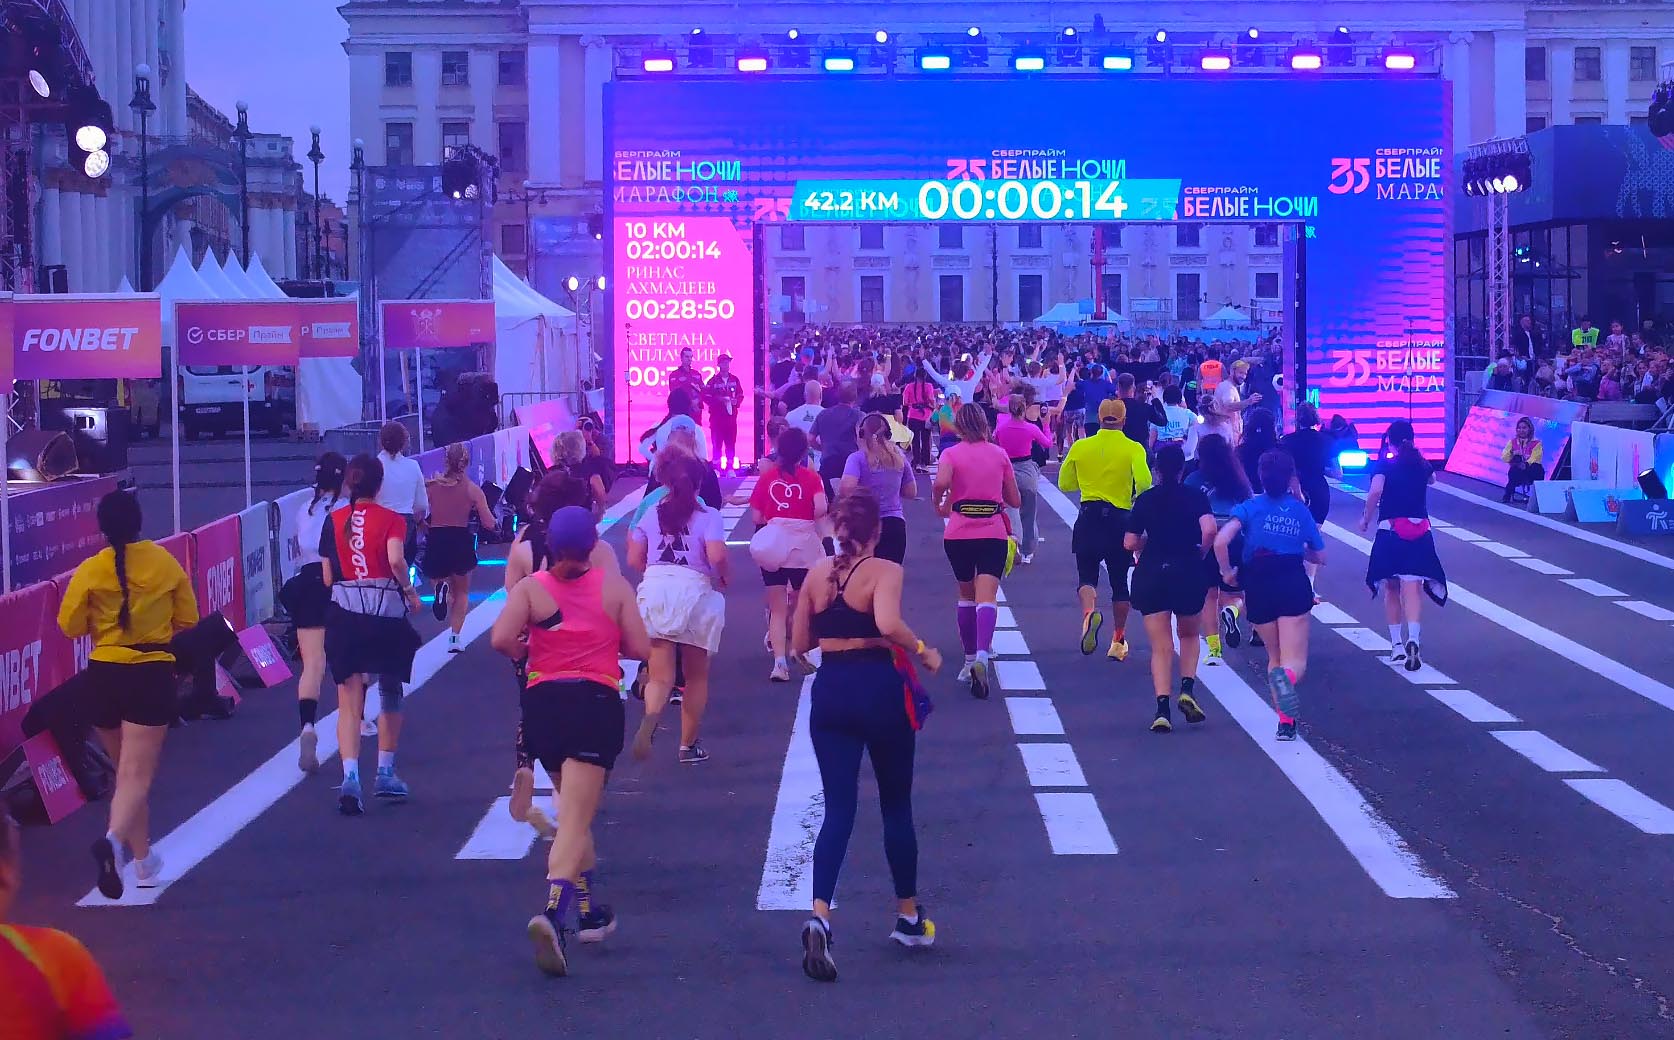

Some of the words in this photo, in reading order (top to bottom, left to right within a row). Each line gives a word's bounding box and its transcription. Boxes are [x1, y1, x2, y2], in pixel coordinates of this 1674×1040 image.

[615, 150, 681, 158] БЕРПРАЙМ
[991, 149, 1066, 157] СБЕРПРАЙМ
[614, 161, 672, 181] ЕЛЫЕ
[676, 160, 742, 181] НОЧИ
[991, 159, 1057, 180] БЕЛЫЕ
[1061, 159, 1126, 180] НОЧИ
[1327, 157, 1371, 195] 35
[1375, 158, 1441, 179] БЕЛЫЕ
[918, 180, 1129, 219] 00:00:14
[1184, 186, 1259, 194] СБЕРПРАЙМ
[1375, 182, 1444, 200] МАРА
[804, 191, 854, 211] 42.2
[861, 191, 899, 211] КМ
[1184, 196, 1250, 217] БЕЛЫЕ
[1253, 196, 1318, 217] НОЧИ
[625, 222, 648, 239] 10
[653, 222, 686, 239] КМ
[625, 240, 722, 260] 02:00:14
[626, 265, 686, 279] РИНАС
[625, 281, 717, 296] АХМАДЕЕВ
[625, 299, 735, 320] 00:28:50
[22, 327, 139, 352] FONBET
[207, 328, 246, 341] СБЕР
[628, 332, 716, 346] СВЕТЛАНА
[1328, 350, 1372, 387] 35
[1376, 350, 1441, 371] БЕЛЫЕ
[1376, 375, 1444, 393] МАРА
[1263, 522, 1301, 536] ЖИЗНИ
[0, 639, 42, 715] NBET
